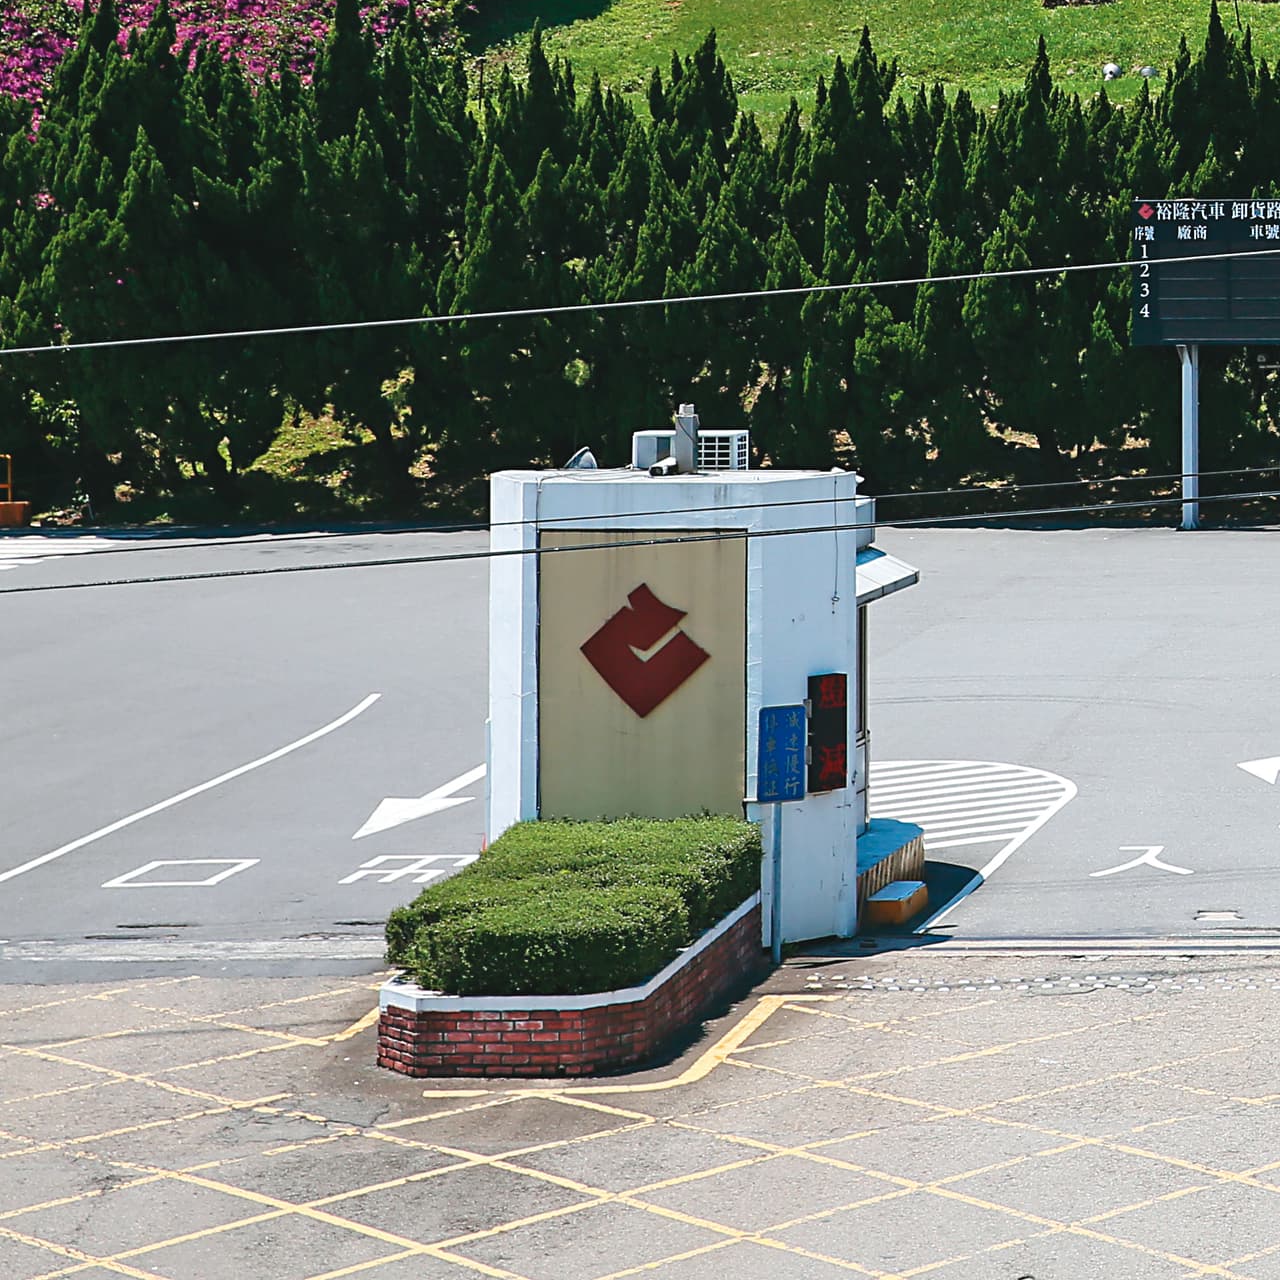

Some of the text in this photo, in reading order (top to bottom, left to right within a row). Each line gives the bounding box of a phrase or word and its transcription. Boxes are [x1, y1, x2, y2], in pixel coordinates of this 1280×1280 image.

[1156, 203, 1225, 220] 裕隆汽車
[1135, 226, 1155, 240] 序號
[1177, 225, 1207, 240] 廠商
[1249, 225, 1280, 240] 車號
[1140, 244, 1148, 259] 1
[1140, 263, 1150, 277] 2
[1140, 283, 1150, 297] 3
[1139, 303, 1150, 318] 4
